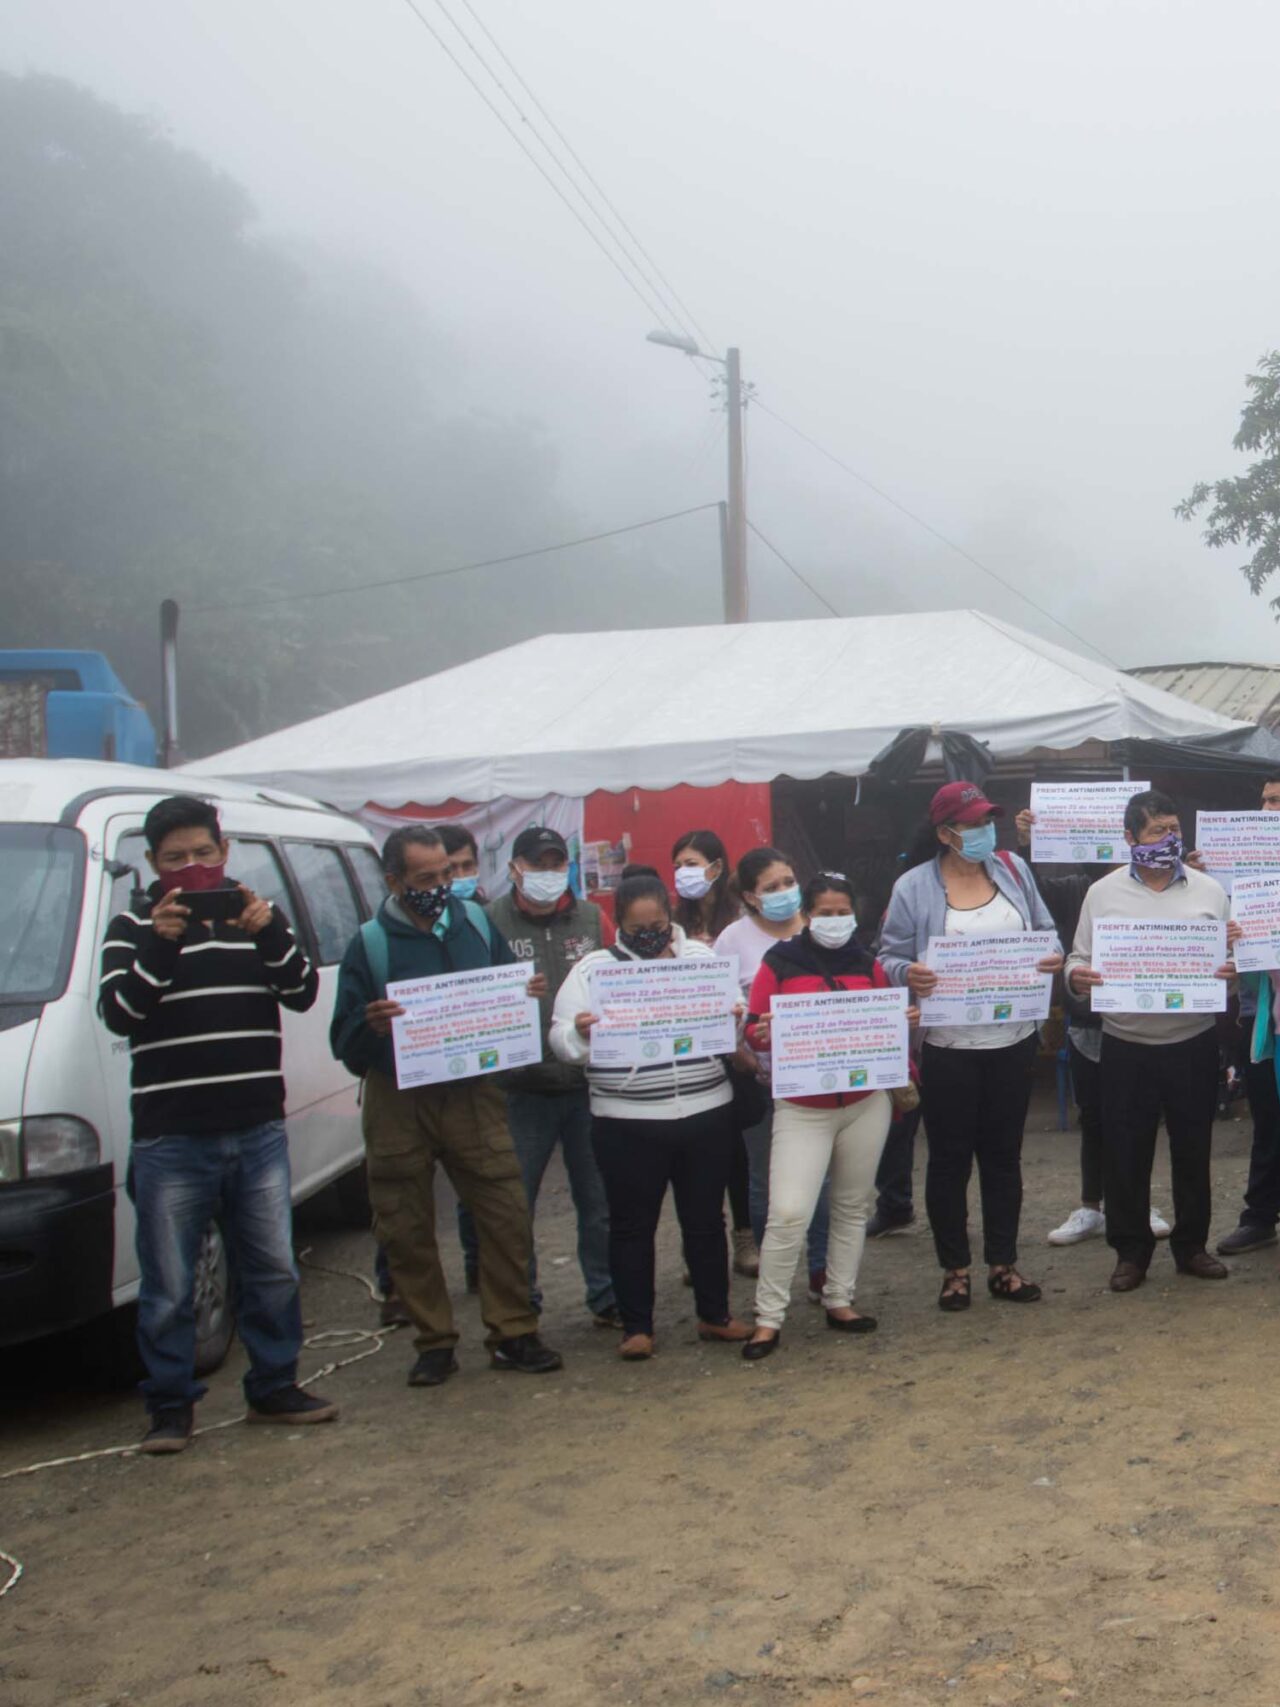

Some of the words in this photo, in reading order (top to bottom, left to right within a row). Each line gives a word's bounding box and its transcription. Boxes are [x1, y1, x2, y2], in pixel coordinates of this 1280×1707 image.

[1234, 881, 1261, 891] FRENTE
[970, 937, 1020, 946] ANTIMINERO
[596, 967, 633, 976] FRENTE
[637, 963, 696, 973] ANTIMINERO
[700, 961, 730, 969] PACTO
[393, 984, 431, 996] FRENTE
[434, 974, 494, 989] ANTIMINERO
[497, 969, 526, 979] PACTO
[776, 1000, 810, 1008] FRENTE
[814, 995, 869, 1006] ANTIMINERO
[872, 993, 900, 1001] PACTO
